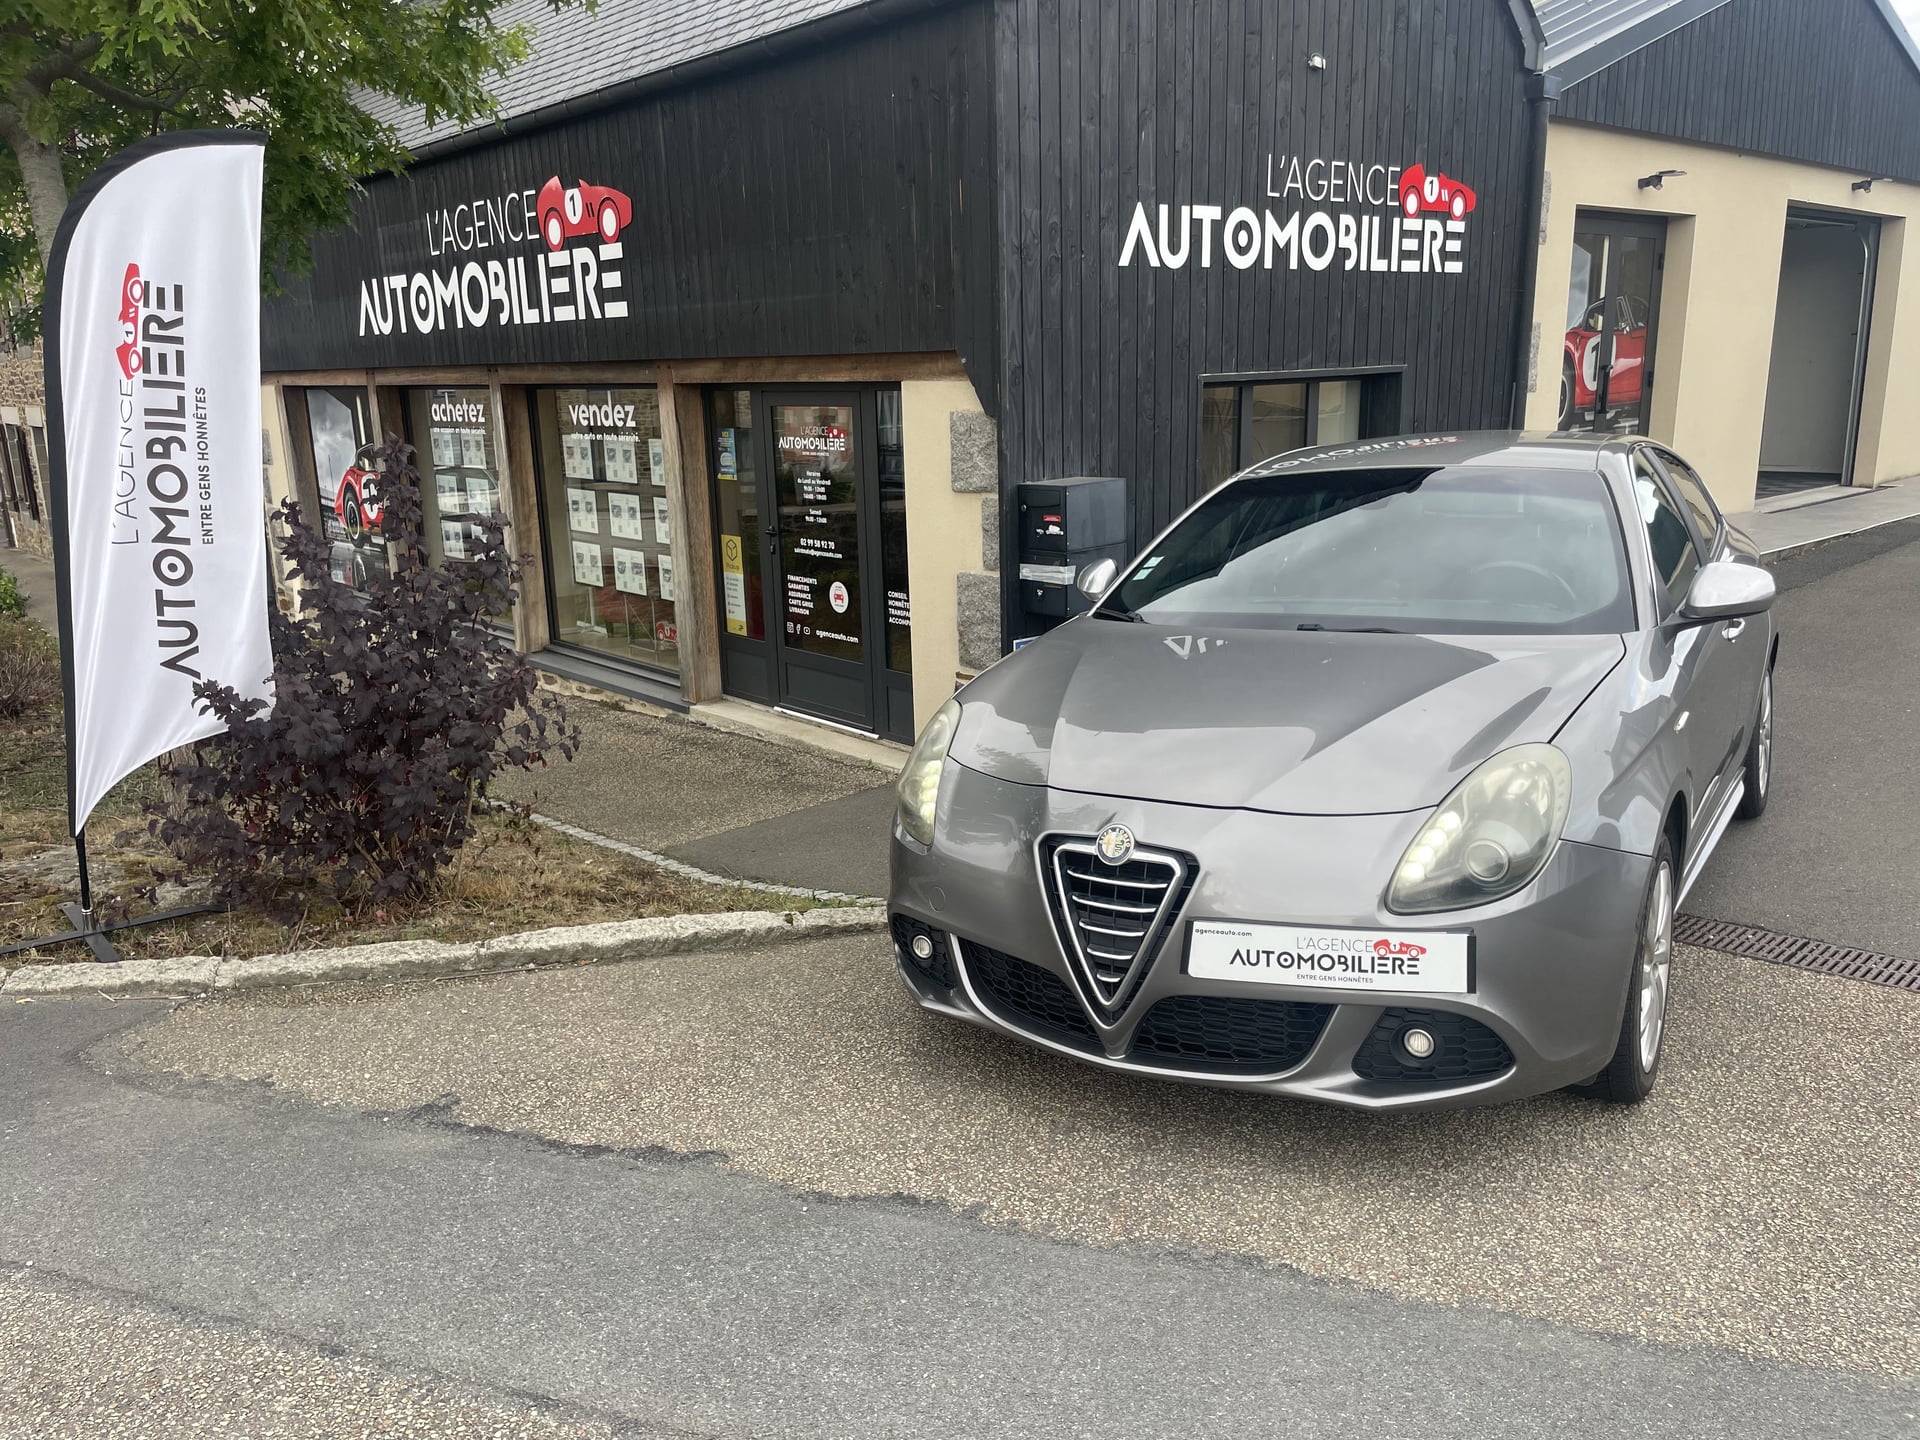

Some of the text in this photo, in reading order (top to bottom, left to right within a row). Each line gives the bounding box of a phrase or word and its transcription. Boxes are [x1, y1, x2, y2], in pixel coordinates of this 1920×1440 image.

[1266, 153, 1401, 207] L'AGENCE
[1428, 179, 1435, 197] 1
[568, 193, 578, 217] 1
[426, 189, 540, 256] L'AGENCE
[431, 391, 486, 423] achetez
[568, 390, 636, 428] vendez
[111, 379, 140, 545] L'AGENCE
[193, 387, 214, 545] ENTRE GENS HONNÊTES
[800, 537, 807, 546] 02
[807, 538, 814, 547] 99
[1195, 928, 1253, 937] agenceauto.com
[1296, 936, 1374, 953] L'AGENCE
[1296, 973, 1317, 981] ENTRE
[1338, 976, 1374, 984] HONNÊTES
